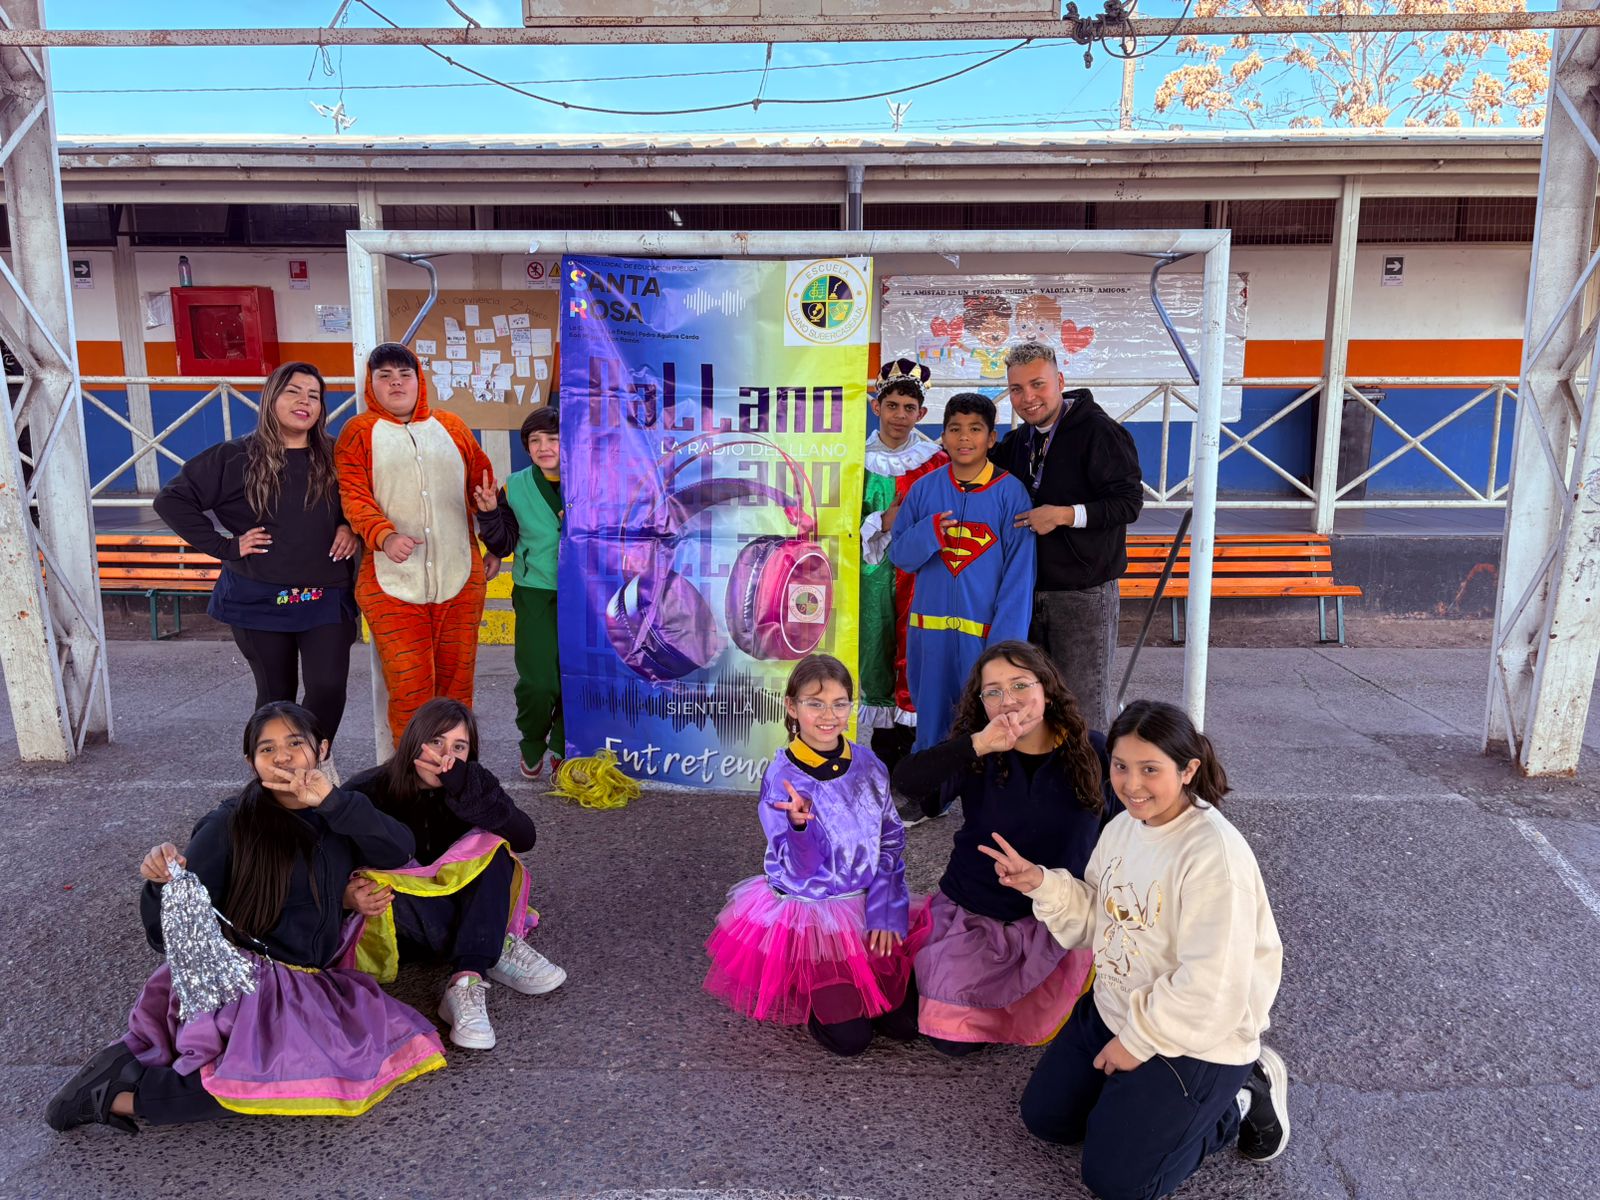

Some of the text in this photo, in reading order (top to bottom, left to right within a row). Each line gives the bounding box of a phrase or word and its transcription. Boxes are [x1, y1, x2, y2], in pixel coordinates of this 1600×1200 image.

[569, 269, 660, 297] SANTA
[805, 263, 849, 280] ESCUELA
[569, 296, 643, 323] ROSA
[790, 305, 865, 340] LLANO SUBERCASEAUX
[660, 441, 848, 458] LA RADIO DEL LLANO
[666, 701, 754, 715] SIENTE LA
[604, 736, 770, 784] Entretenc
